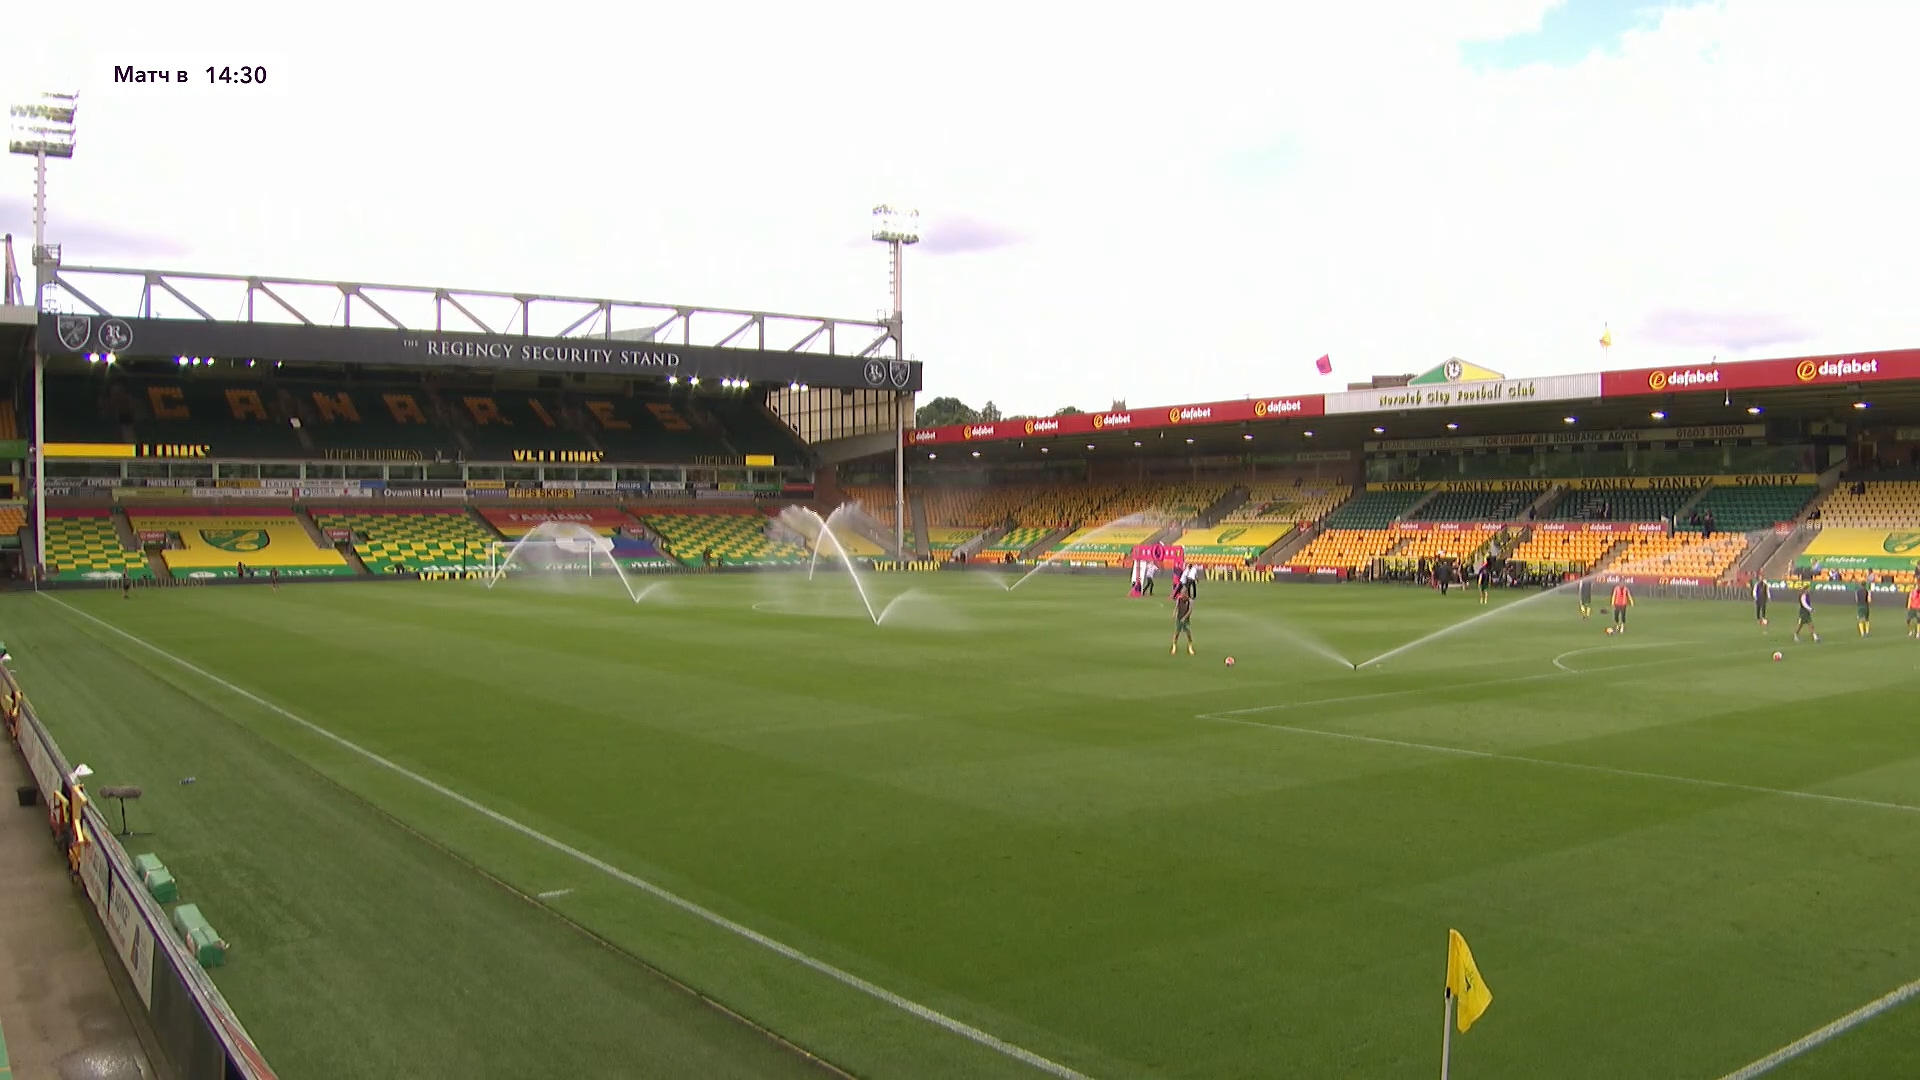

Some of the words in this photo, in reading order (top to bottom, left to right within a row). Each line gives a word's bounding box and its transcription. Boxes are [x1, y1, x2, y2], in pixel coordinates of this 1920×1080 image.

[403, 339, 418, 347] THE
[427, 340, 513, 358] REGENCY
[521, 345, 613, 364] SECURITY
[620, 351, 680, 367] STAND
[1819, 358, 1878, 377] dafabet
[1667, 369, 1719, 387] dafabet
[1379, 389, 1422, 408] Norwich
[1427, 392, 1450, 405] City
[1457, 384, 1502, 401] Football
[1508, 382, 1535, 398] Club
[1180, 407, 1211, 421] dafabet
[1267, 400, 1301, 416] dafabet
[1104, 413, 1131, 426] dafabet
[972, 426, 994, 438] dafabet
[1034, 419, 1059, 433] dafabet
[915, 431, 936, 441] dafabet
[1553, 431, 1603, 443] INSURANCE
[1608, 431, 1640, 441] ADVICE
[1382, 482, 1426, 491] STANLEY
[1447, 481, 1493, 492] STANLEY
[1501, 480, 1552, 491] STANLEY
[1581, 478, 1635, 489] STANLEY
[1649, 477, 1707, 488] STANLEY
[1736, 475, 1798, 486] STANLEY
[384, 488, 421, 497] Ovamill
[424, 488, 441, 497] Ltd
